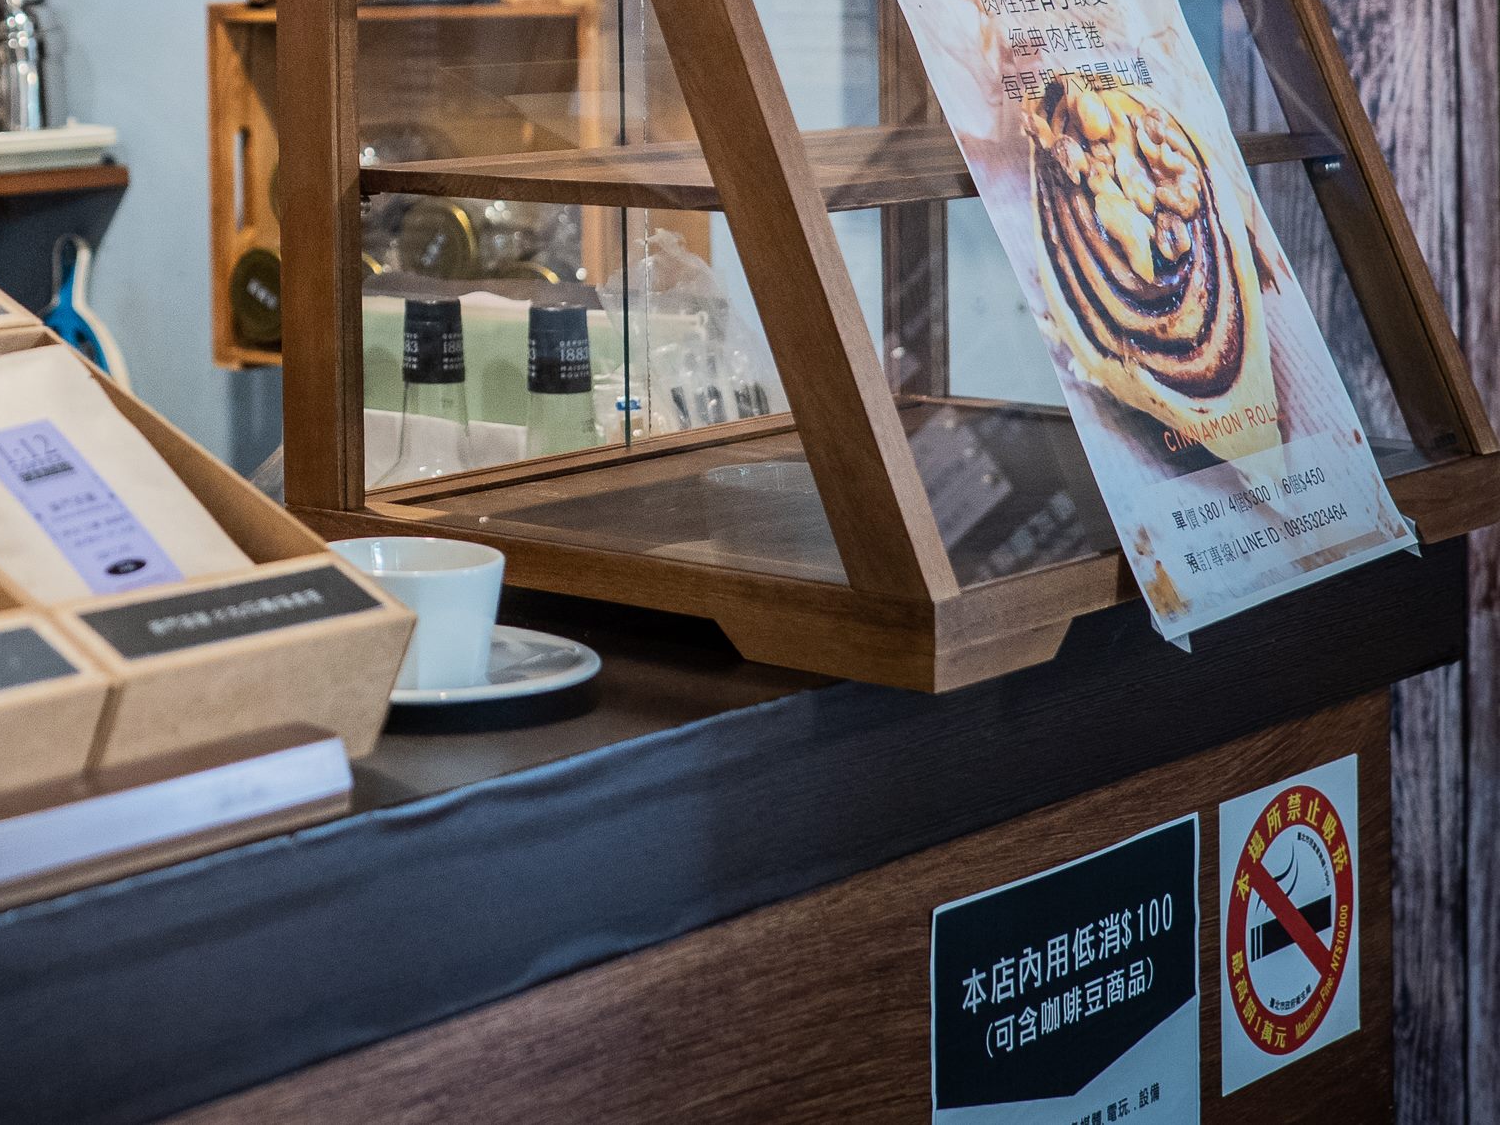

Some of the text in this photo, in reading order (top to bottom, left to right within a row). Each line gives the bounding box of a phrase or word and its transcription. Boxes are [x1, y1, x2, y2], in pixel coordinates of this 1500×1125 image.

[1008, 21, 1105, 57] 經典肉桂捲
[1163, 401, 1286, 452] CINNAMON ROLL
[961, 892, 1173, 1014] 本店內用低消$100
[986, 956, 1154, 1058] (可含咖啡豆商品)
